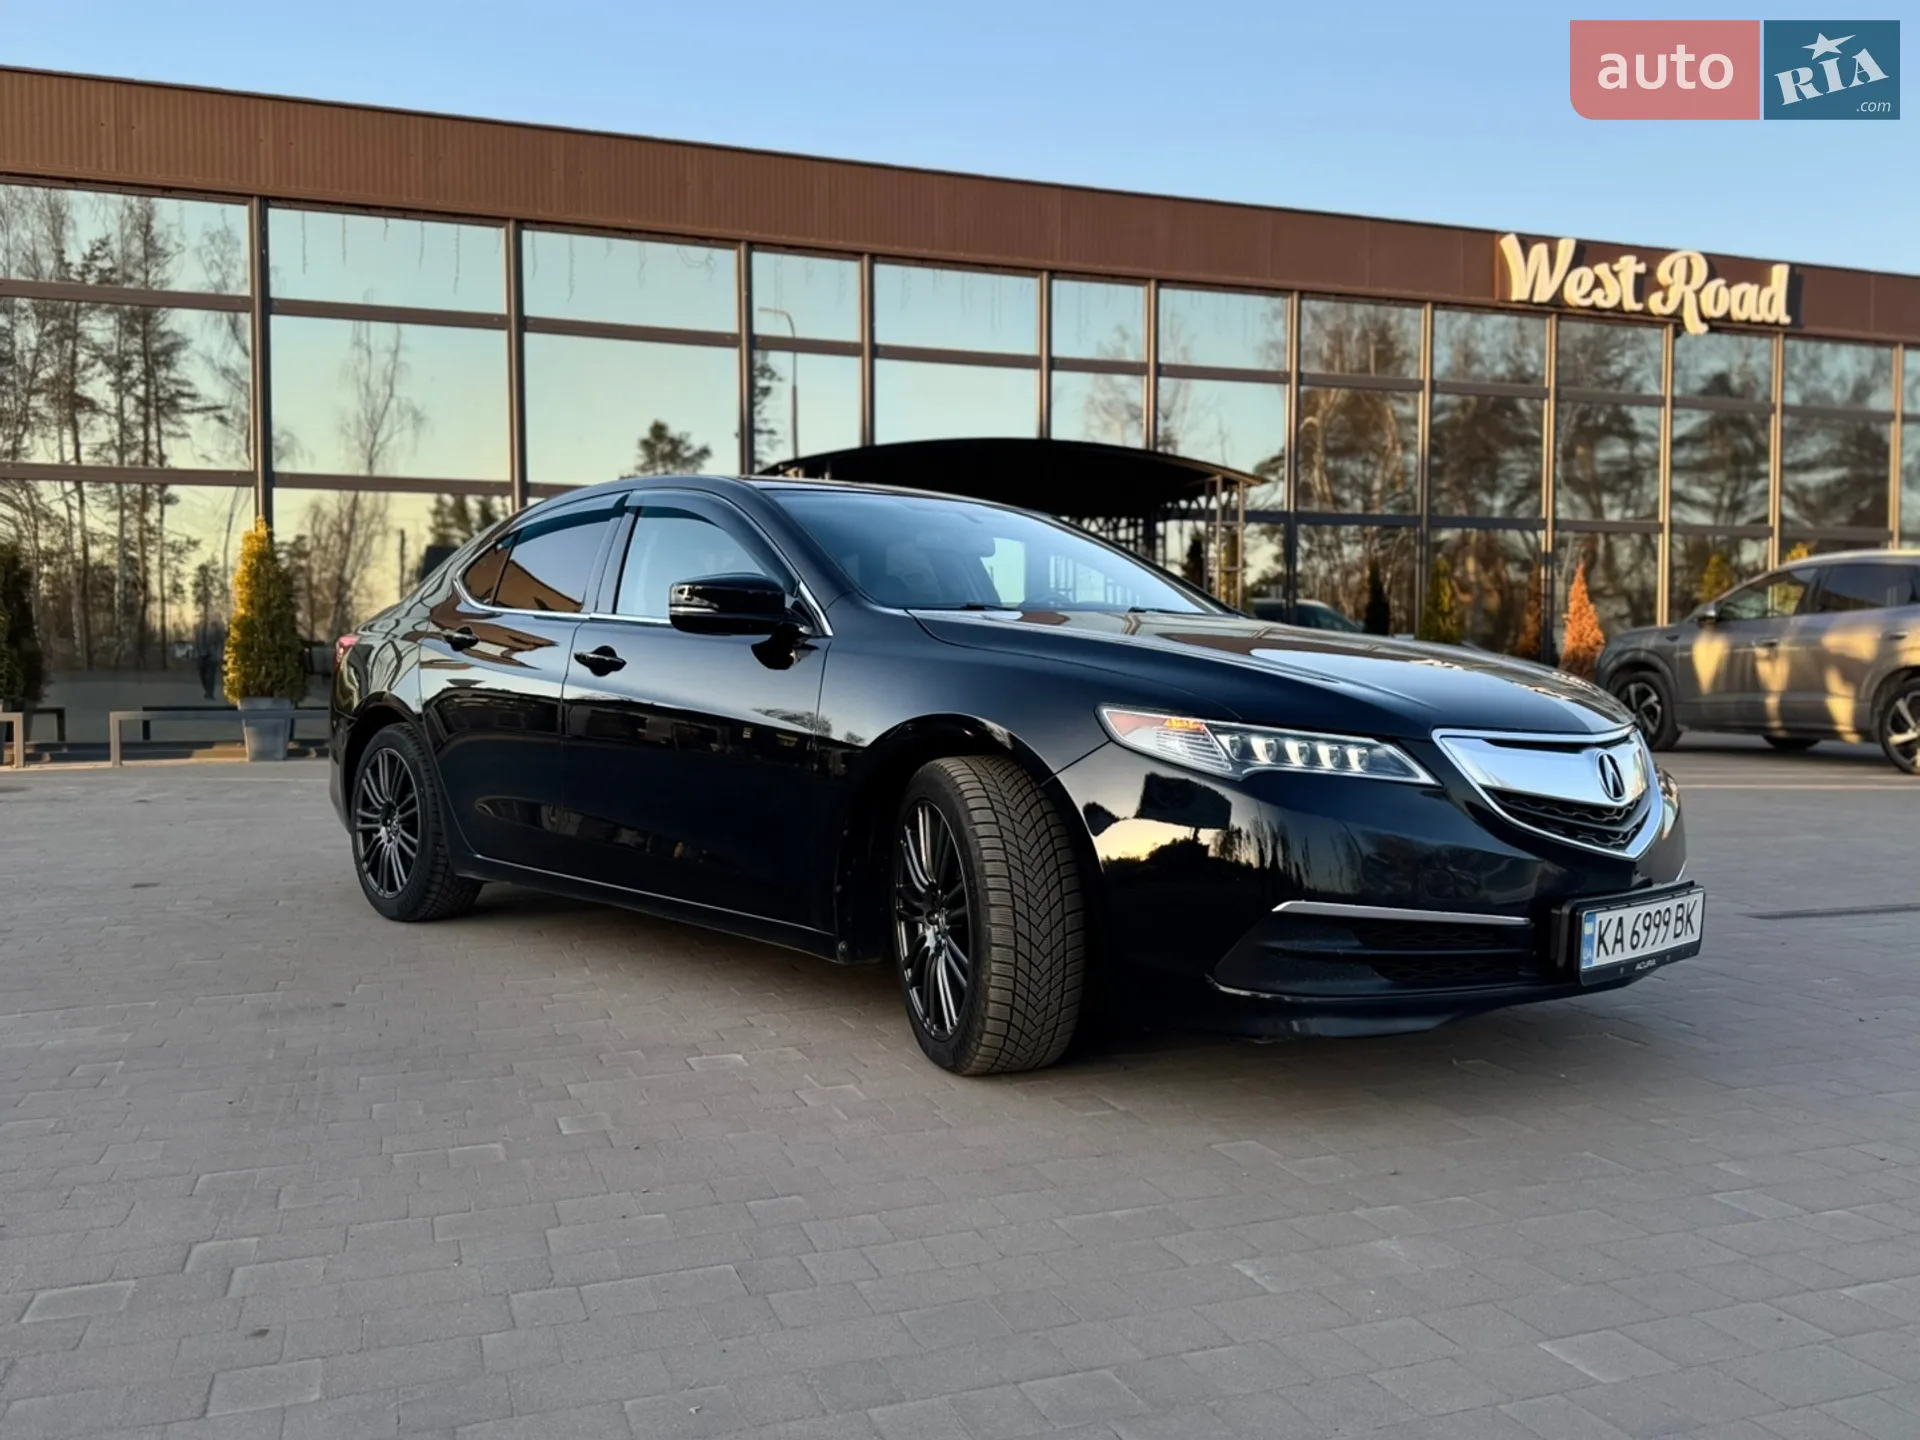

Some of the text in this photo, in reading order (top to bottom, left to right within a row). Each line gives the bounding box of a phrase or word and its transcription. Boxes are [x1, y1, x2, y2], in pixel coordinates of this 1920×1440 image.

[1500, 233, 1792, 335] West Road
[1596, 916, 1625, 958] KA
[1630, 907, 1672, 950] 6999
[1673, 899, 1698, 939] BK
[1635, 959, 1657, 971] ACURA
